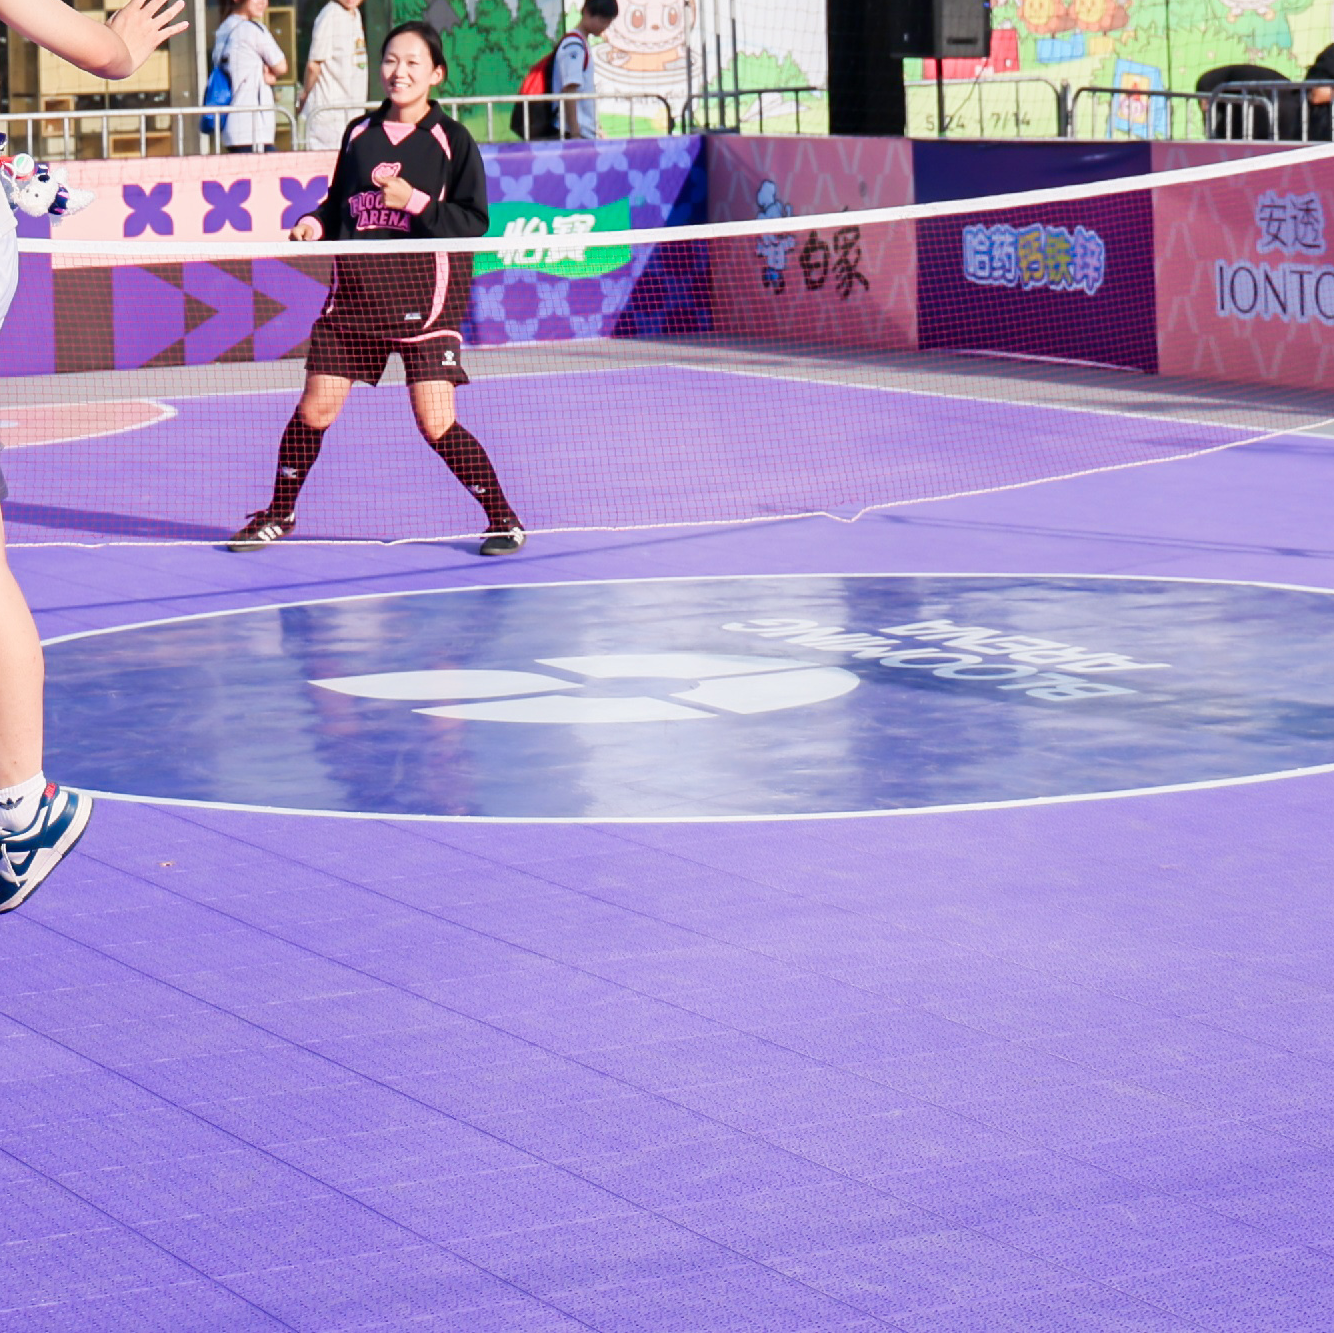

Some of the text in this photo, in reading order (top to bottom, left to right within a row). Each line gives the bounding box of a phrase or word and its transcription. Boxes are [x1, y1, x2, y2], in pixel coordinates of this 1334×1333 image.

[924, 112, 966, 132] 524
[360, 210, 408, 230] ARENA
[1259, 198, 1323, 250] 安透
[721, 617, 1138, 702] BLOOMING
[879, 619, 1173, 673] ARENA
